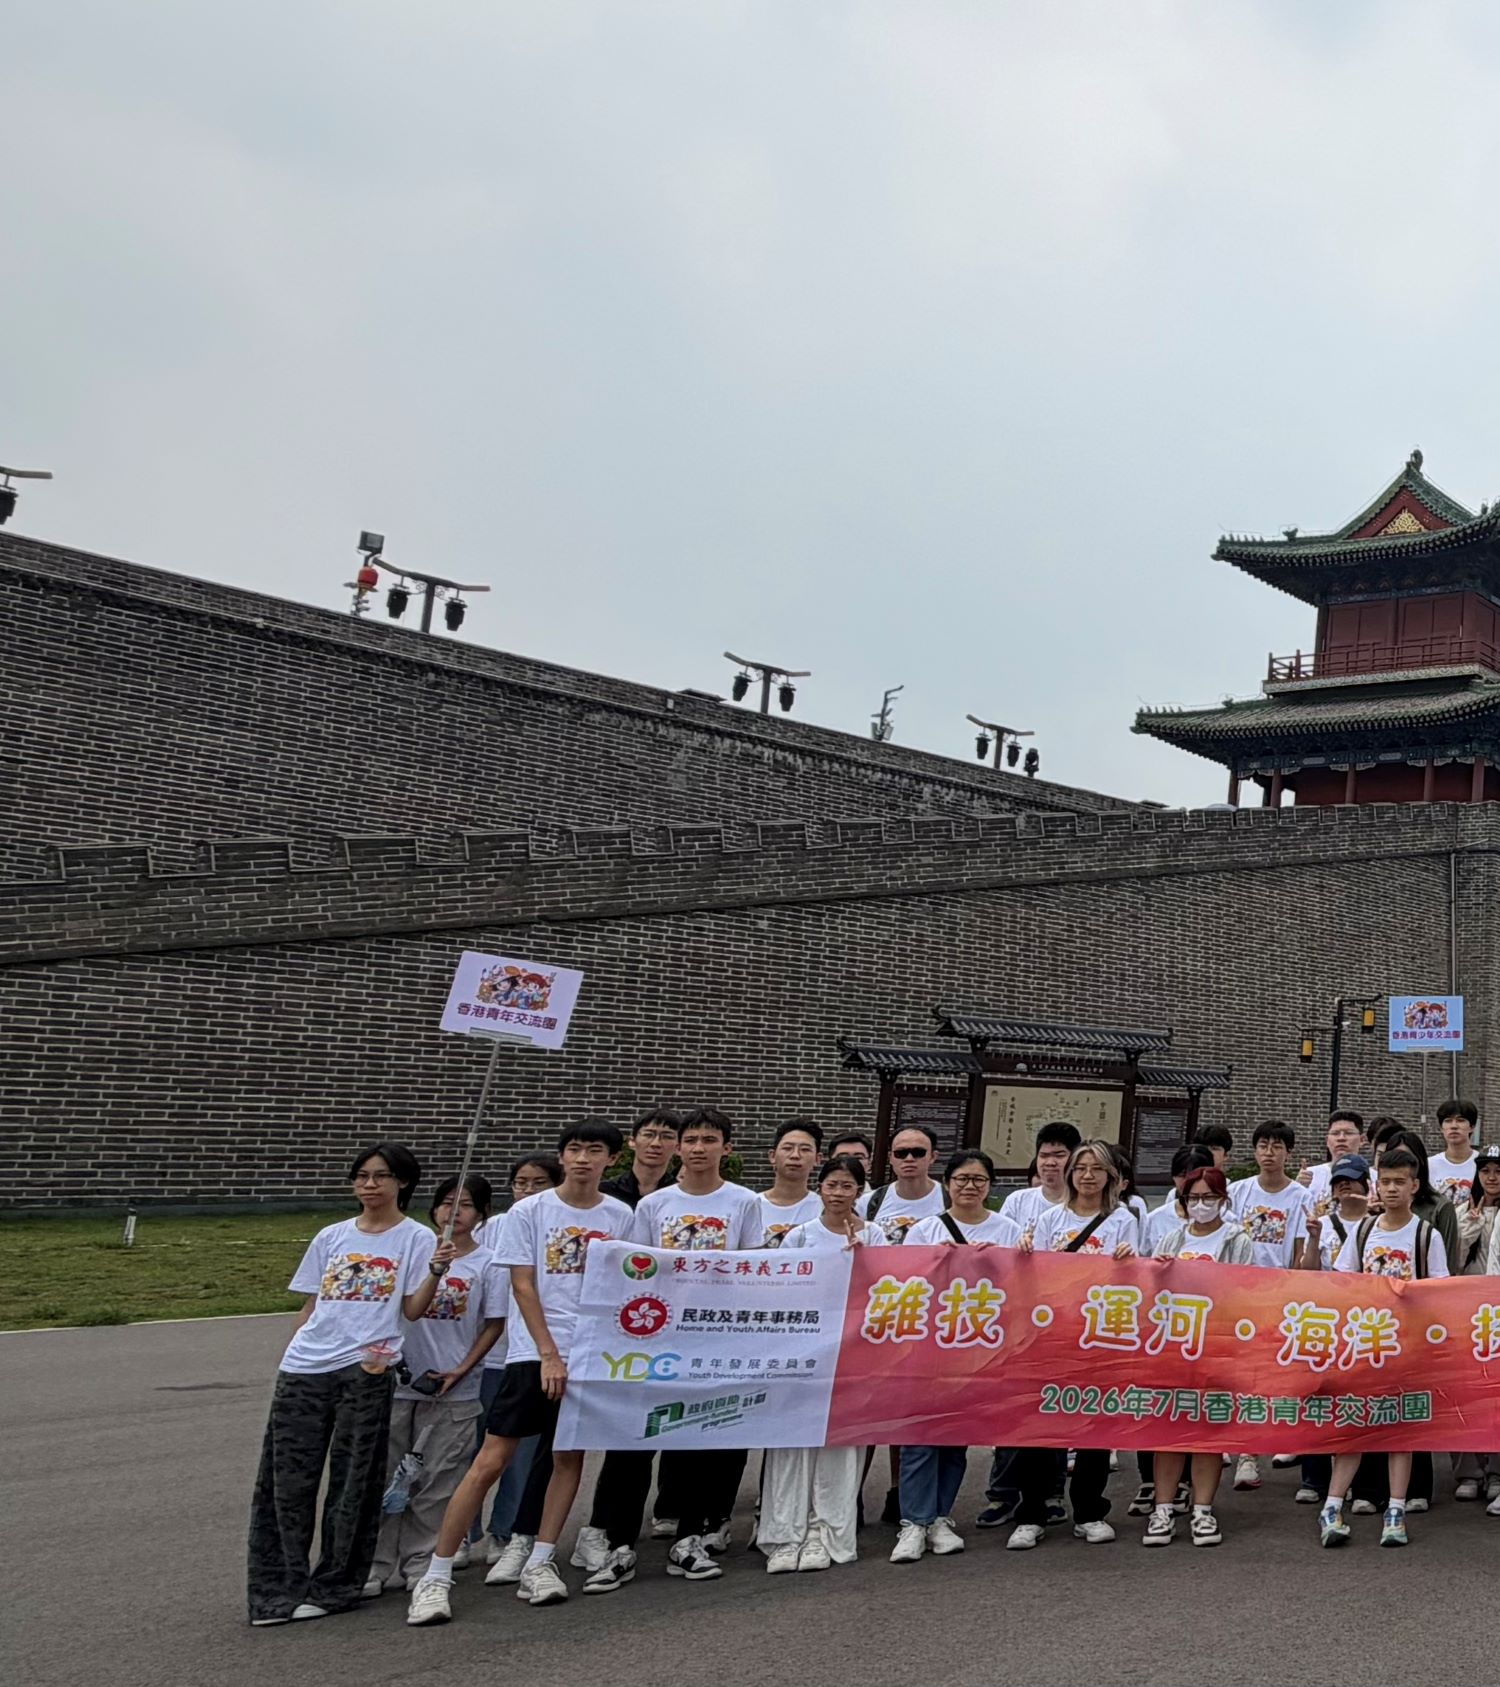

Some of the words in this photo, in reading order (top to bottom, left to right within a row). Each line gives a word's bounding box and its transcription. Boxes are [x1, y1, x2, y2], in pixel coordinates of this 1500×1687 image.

[457, 1002, 557, 1030] 香港青年交流團
[672, 1256, 814, 1277] 東方之珠義工團
[681, 1308, 820, 1324] 民政及青年事務局
[676, 1324, 704, 1332] Home
[706, 1324, 724, 1332] and
[726, 1324, 754, 1333] Youth
[756, 1325, 785, 1333] Affairs
[788, 1325, 820, 1334] Bureau
[690, 1357, 818, 1370] 青年發展委員會
[688, 1372, 711, 1380] Youth
[712, 1372, 765, 1381] Development
[1040, 1384, 1432, 1427] 2026年7月香港青年交流團
